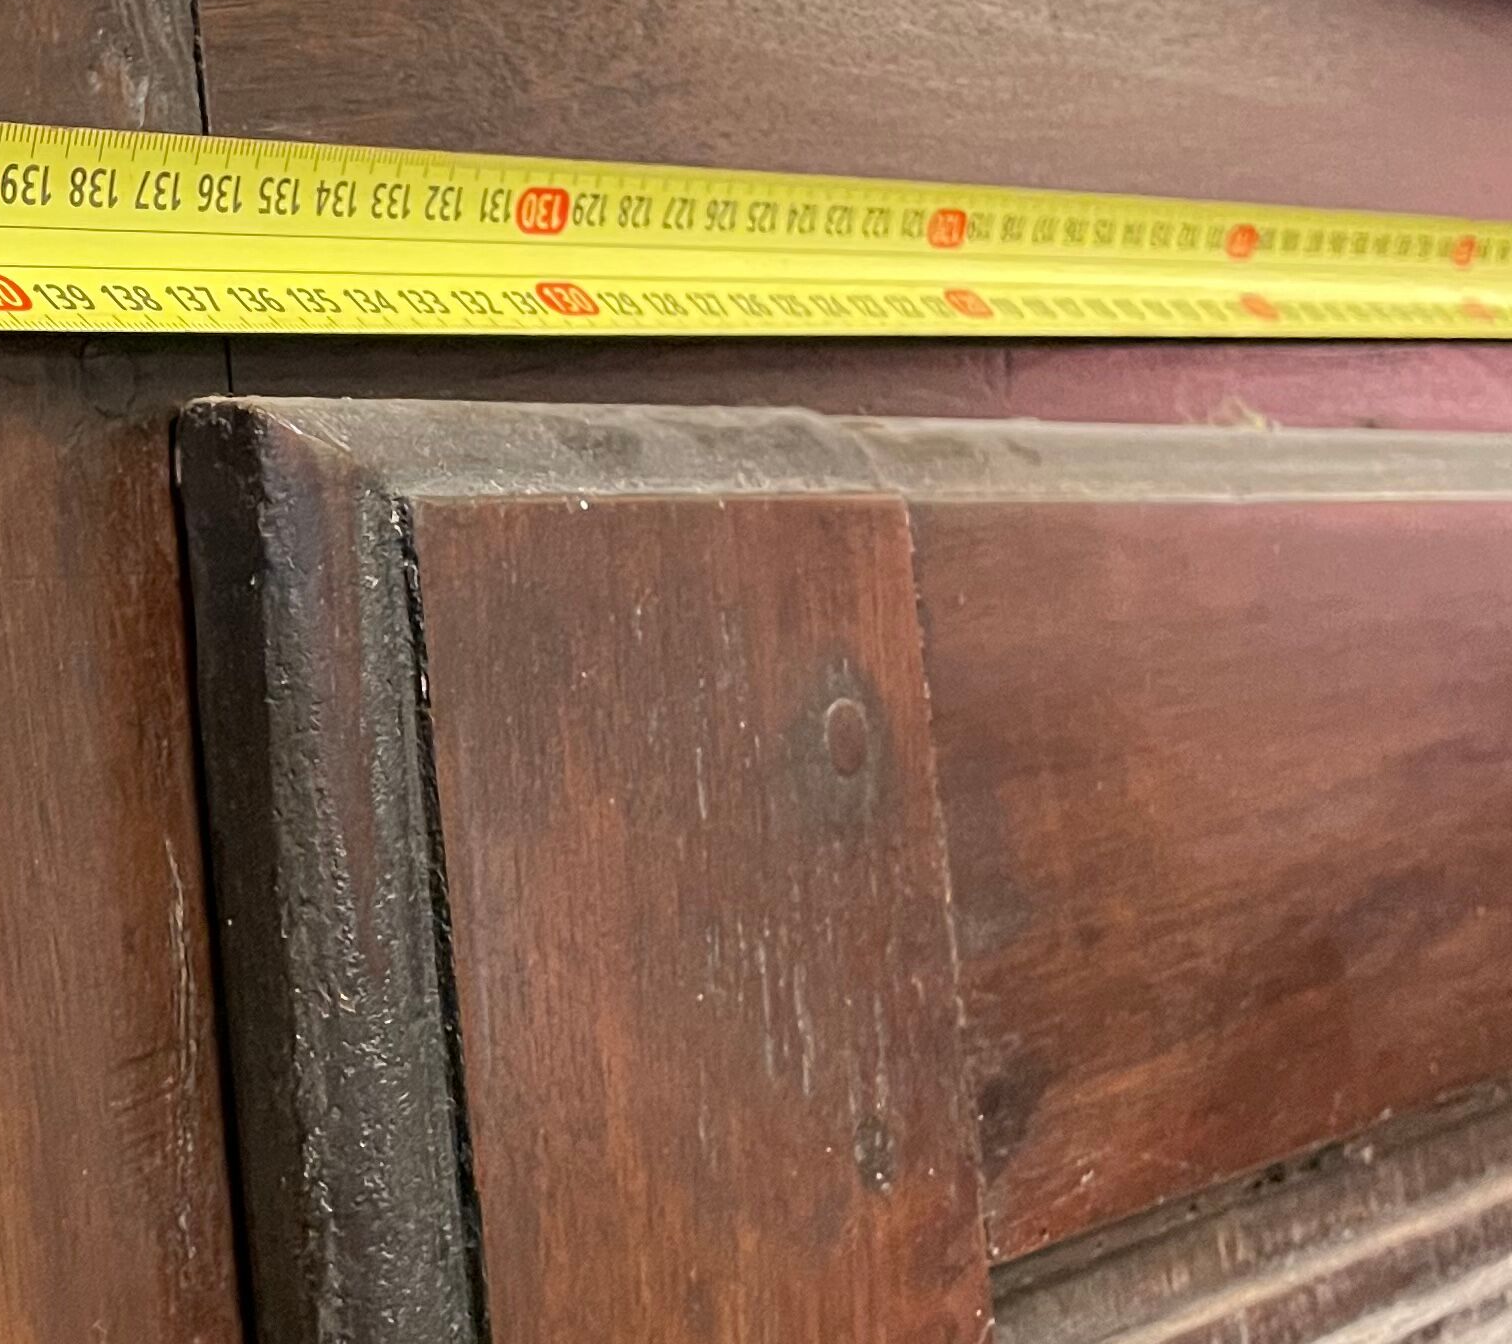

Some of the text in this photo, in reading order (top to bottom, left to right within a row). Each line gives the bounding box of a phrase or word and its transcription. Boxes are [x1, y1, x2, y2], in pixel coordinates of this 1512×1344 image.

[1, 163, 52, 206] 139
[69, 167, 119, 209] 138
[134, 170, 181, 211] 137
[197, 173, 242, 214] 136
[258, 176, 300, 216] 135
[315, 179, 357, 218] 134
[370, 182, 411, 220] 133
[424, 185, 464, 222] 132
[479, 187, 512, 223] 131
[524, 192, 561, 230] 130
[572, 192, 609, 227] 129
[617, 195, 653, 229] 128
[661, 196, 696, 231] 127
[704, 199, 738, 232] 126
[746, 201, 779, 234] 125
[33, 284, 94, 311] 139
[101, 285, 162, 312] 138
[165, 286, 221, 313] 137
[226, 286, 286, 313] 136
[287, 287, 342, 314] 135
[342, 288, 399, 314] 134
[397, 289, 449, 315] 133
[450, 290, 504, 316] 132
[501, 291, 548, 316] 131
[542, 287, 595, 313] 130
[597, 291, 643, 316] 129
[642, 292, 688, 317] 128
[686, 292, 729, 318] 127
[728, 293, 773, 318] 126
